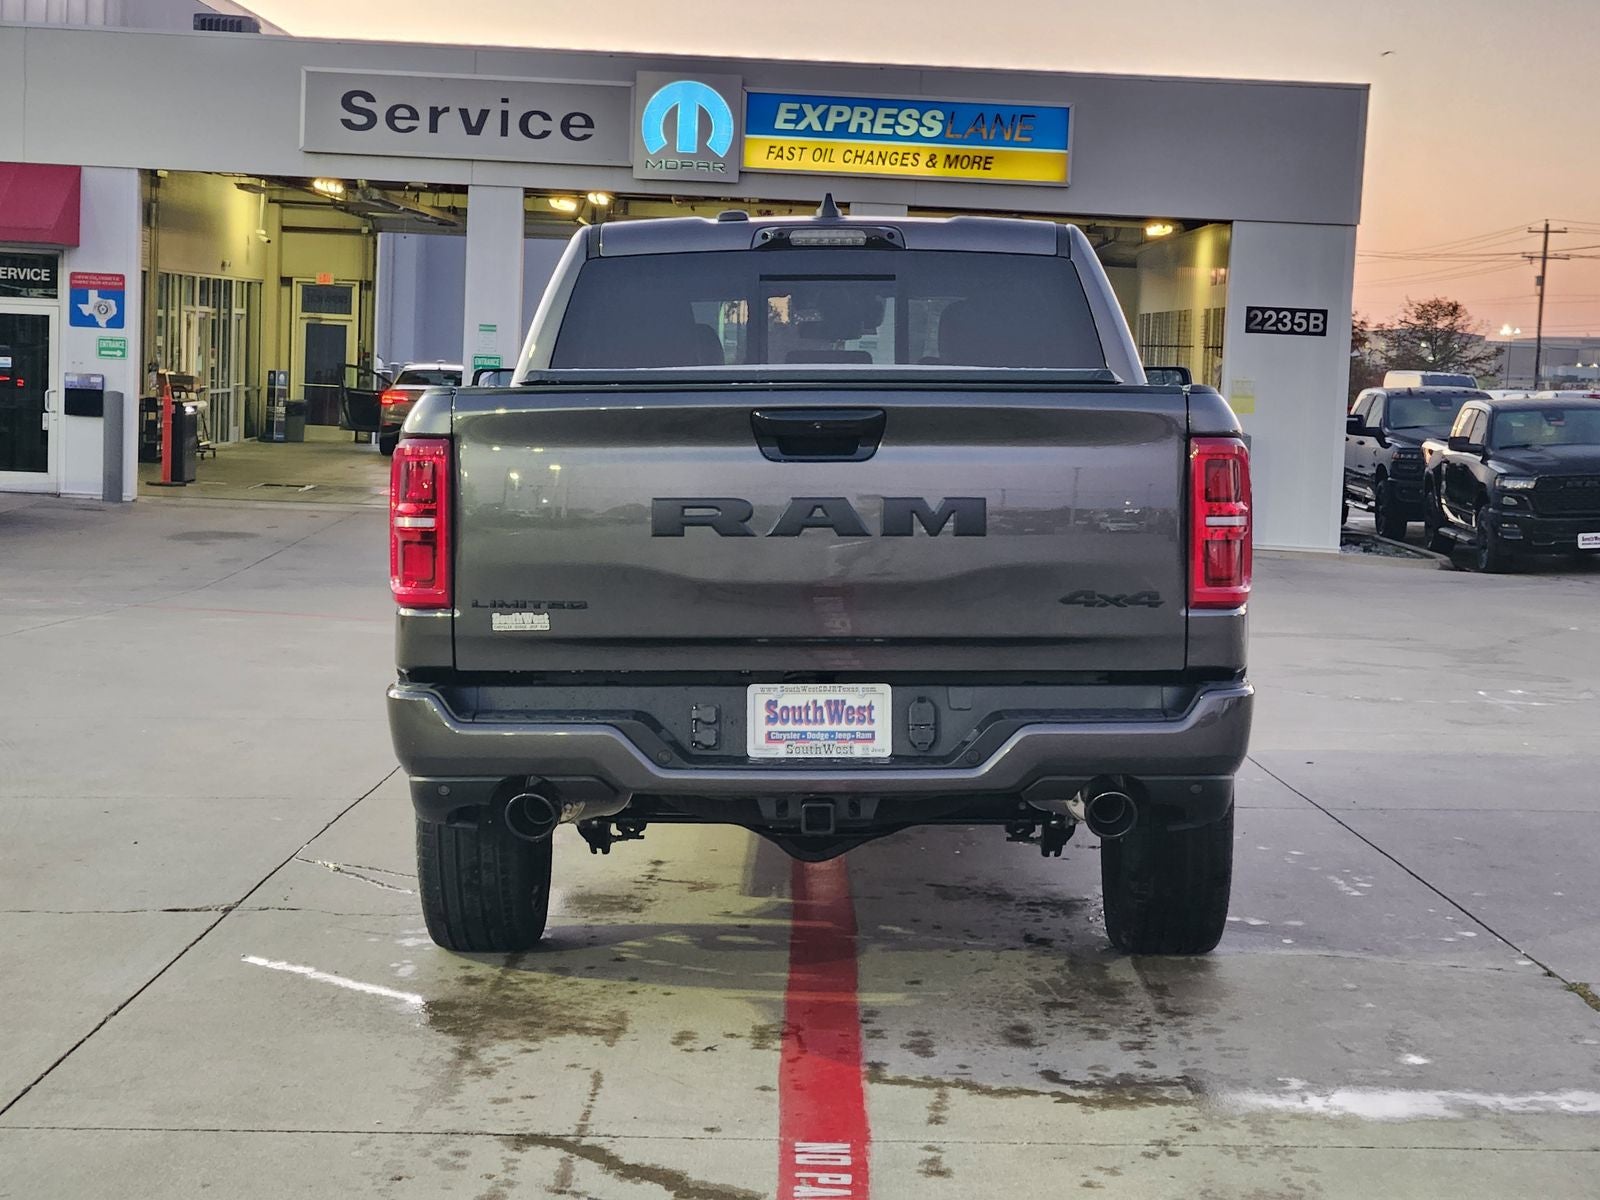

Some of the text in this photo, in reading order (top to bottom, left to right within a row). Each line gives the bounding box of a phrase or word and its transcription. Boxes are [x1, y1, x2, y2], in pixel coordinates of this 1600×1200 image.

[340, 89, 595, 142] Service
[645, 159, 727, 174] MOPAR
[766, 145, 994, 171] FAST OIL CHANGES & MORE
[1248, 309, 1325, 333] 2235B
[651, 497, 987, 537] RAM
[471, 599, 589, 609] LIMITED
[765, 698, 876, 726] SouthWest
[770, 731, 872, 741] Chrysler Dodge Jeep Ram
[786, 743, 855, 755] SouthWest
[792, 1142, 853, 1200] NO PA
